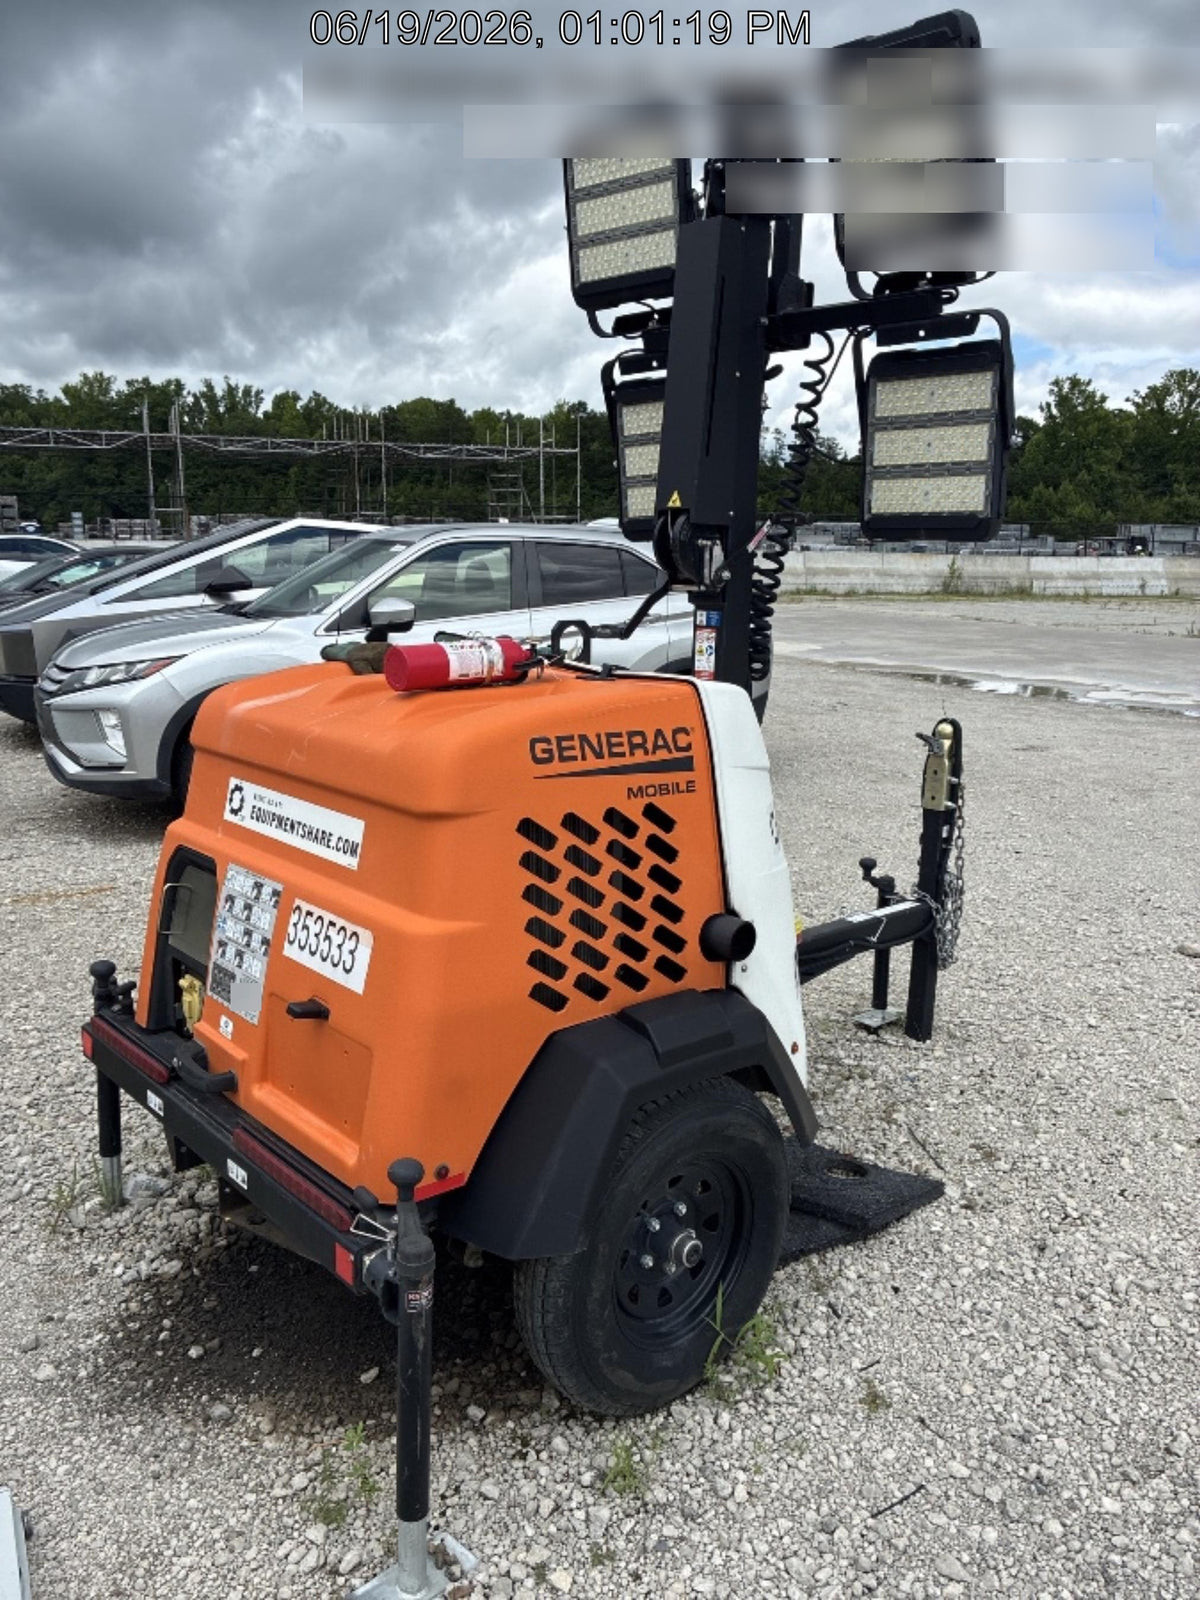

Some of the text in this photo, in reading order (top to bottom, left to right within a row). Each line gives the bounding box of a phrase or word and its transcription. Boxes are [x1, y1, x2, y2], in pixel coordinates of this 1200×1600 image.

[529, 727, 693, 765] GENERAC
[627, 780, 696, 800] MOBILE
[250, 805, 360, 859] EQUIPMENTSHARE.COM
[287, 904, 360, 975] 353533
